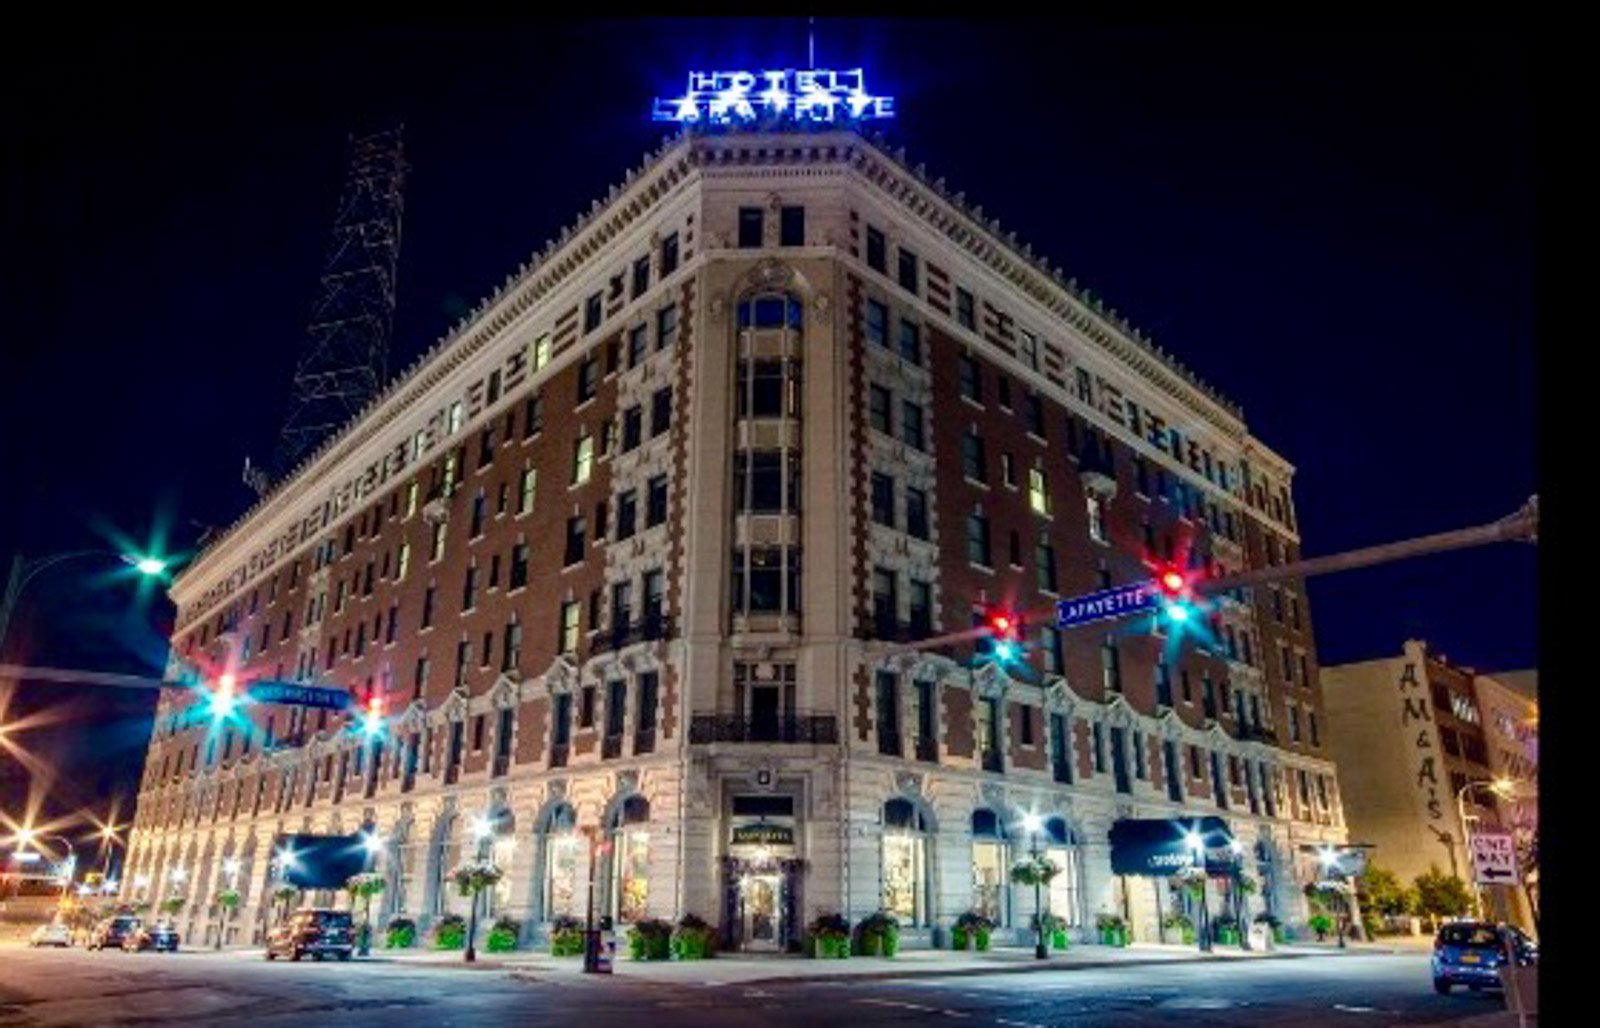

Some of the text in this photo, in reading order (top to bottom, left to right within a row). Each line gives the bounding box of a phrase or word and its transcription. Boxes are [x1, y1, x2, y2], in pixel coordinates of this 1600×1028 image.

[695, 71, 851, 93] HOTEL
[1058, 590, 1144, 622] LAFAYETTE
[1474, 837, 1509, 851] ONE
[1477, 853, 1510, 865] WAY
